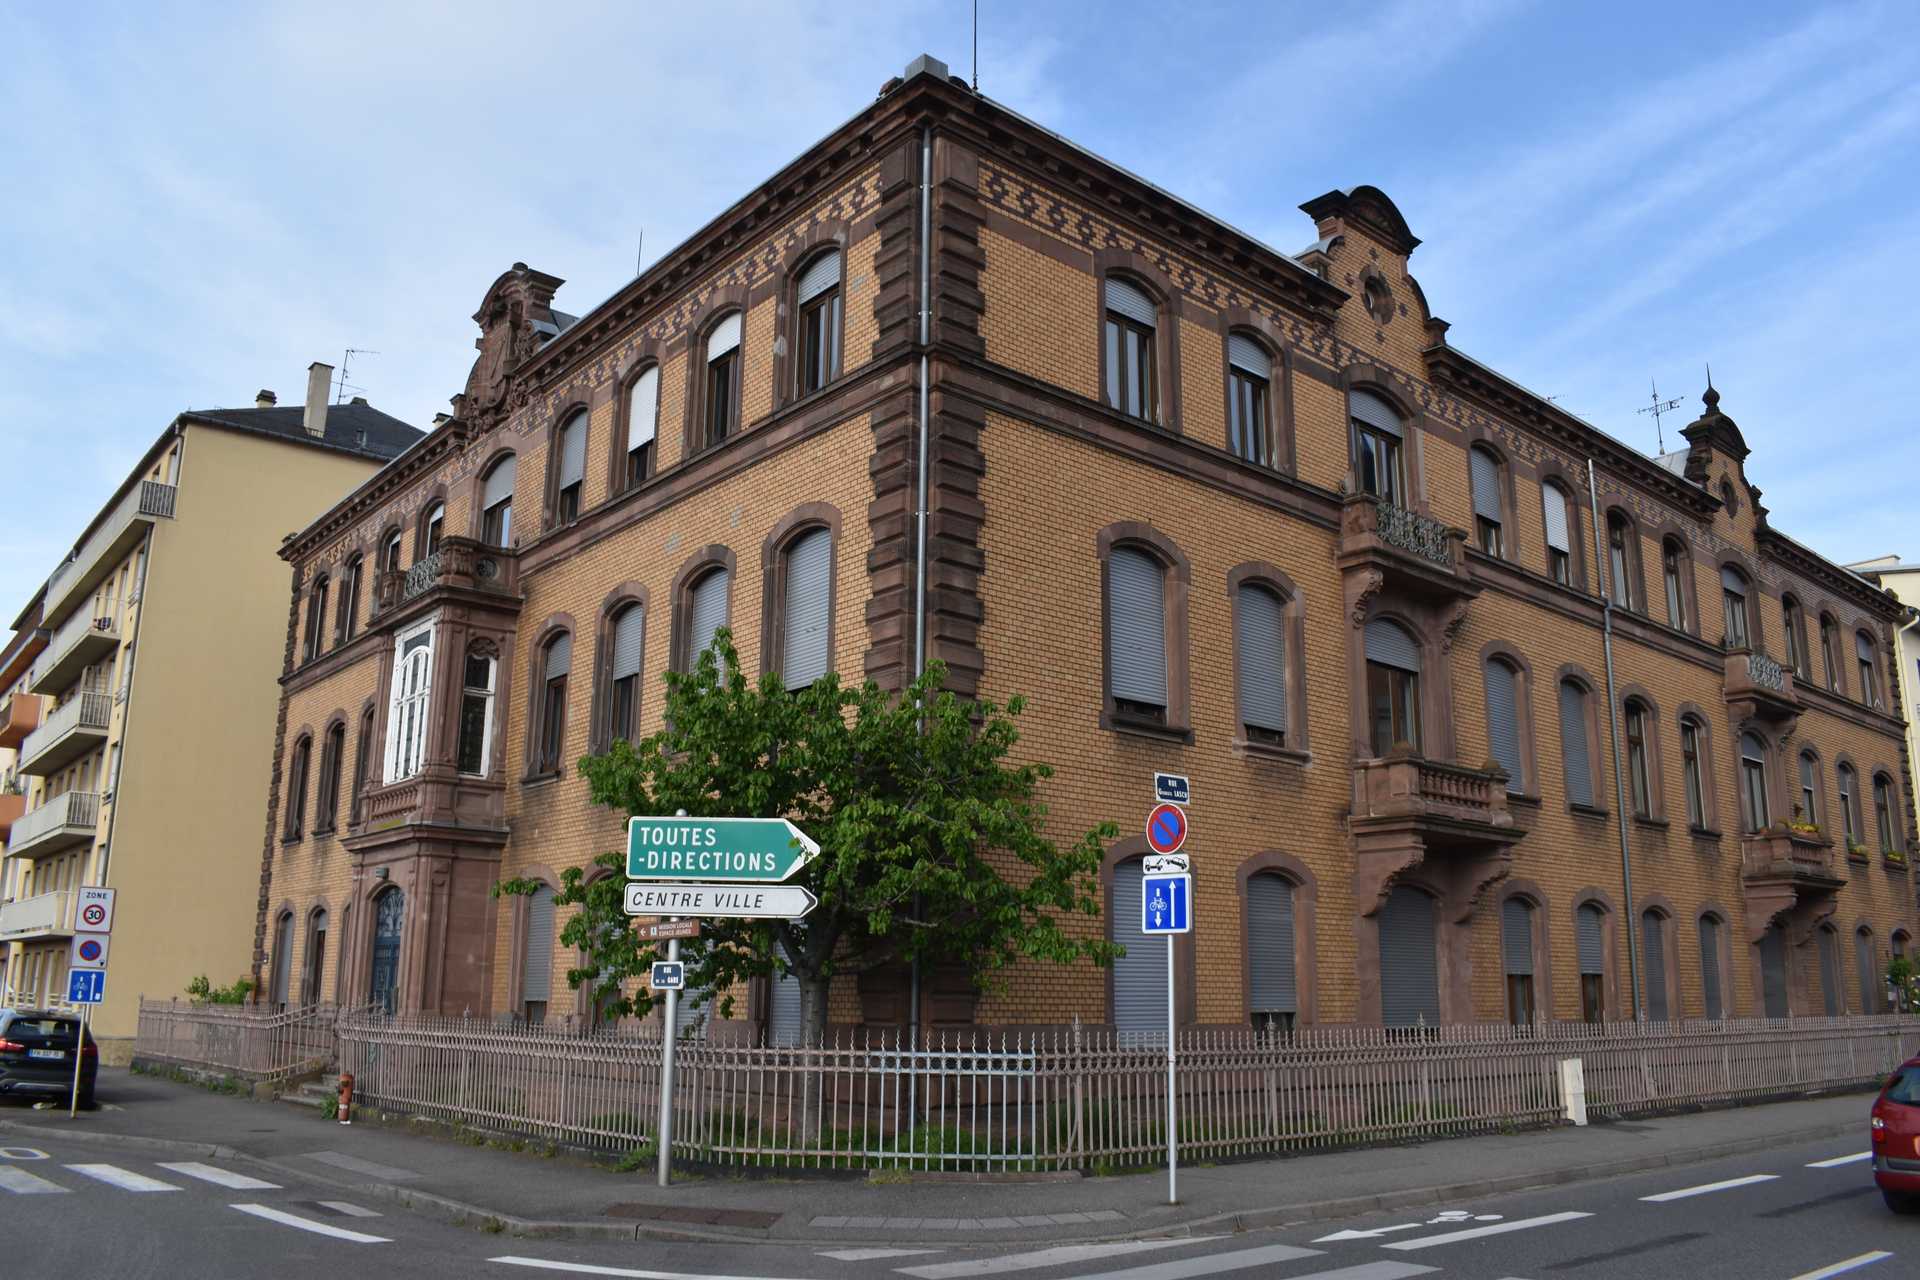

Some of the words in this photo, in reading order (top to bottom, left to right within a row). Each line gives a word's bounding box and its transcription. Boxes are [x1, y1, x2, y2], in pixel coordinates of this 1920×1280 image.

[640, 827, 717, 846] TOUTES
[86, 891, 107, 899] ZONE
[632, 891, 704, 908] CENTRE
[714, 893, 764, 909] VILLE
[88, 910, 101, 919] 30
